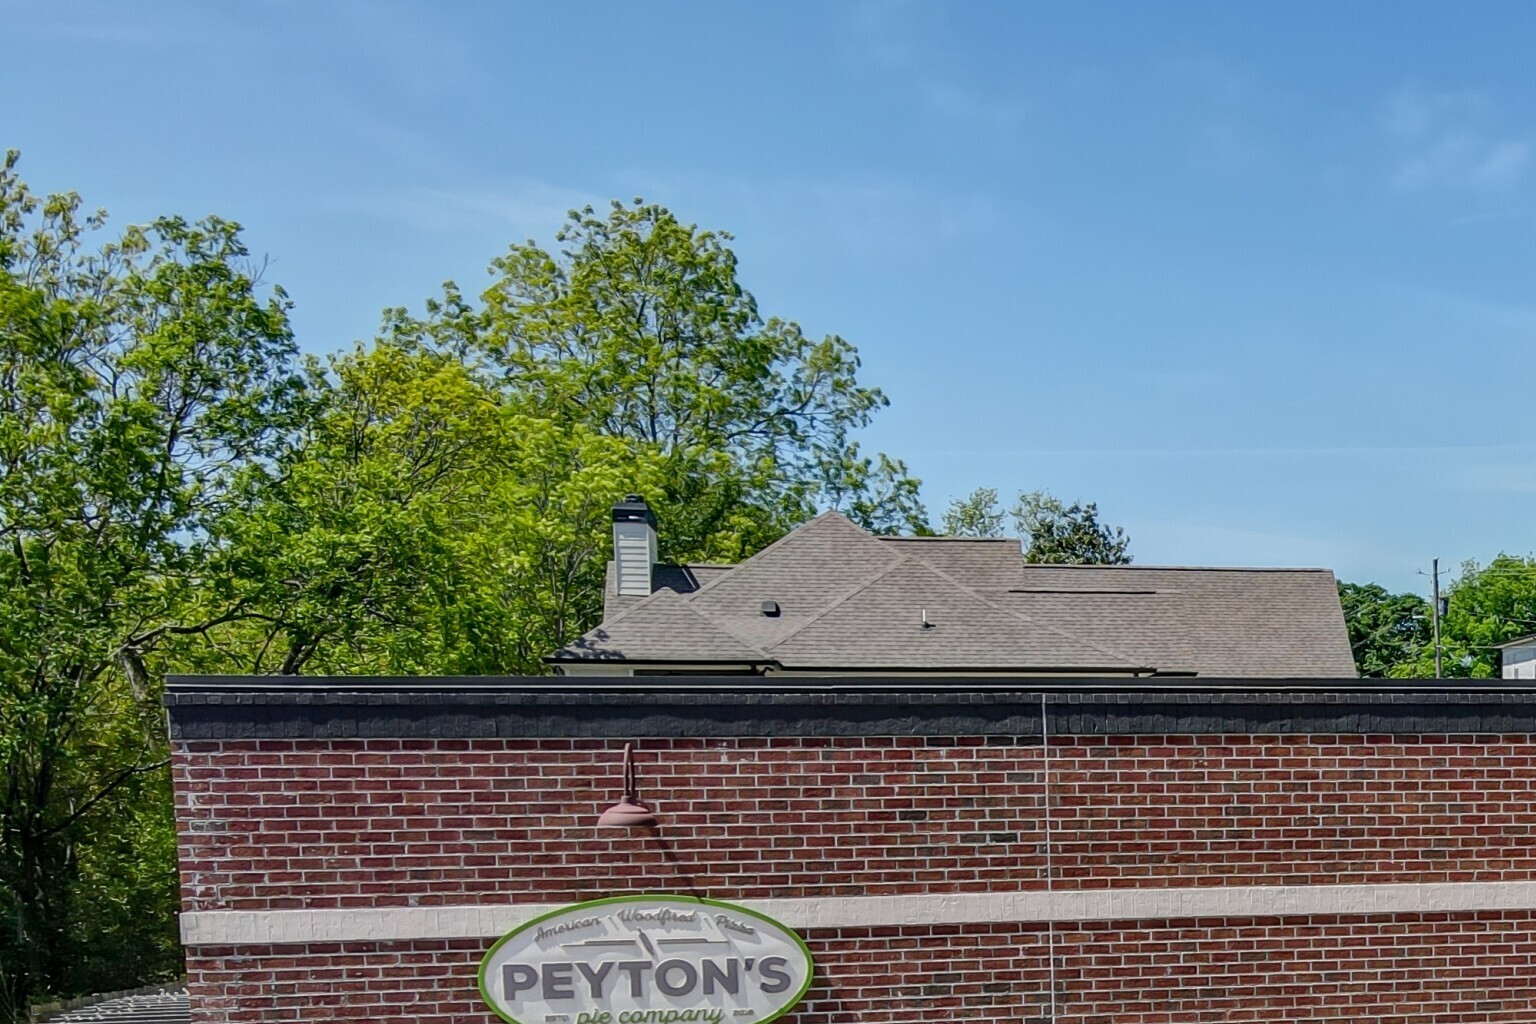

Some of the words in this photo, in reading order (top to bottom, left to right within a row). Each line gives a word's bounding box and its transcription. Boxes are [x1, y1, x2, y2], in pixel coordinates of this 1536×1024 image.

[534, 916, 601, 943] American
[616, 907, 698, 926] Woodfired
[502, 956, 792, 1001] PEYTON'S
